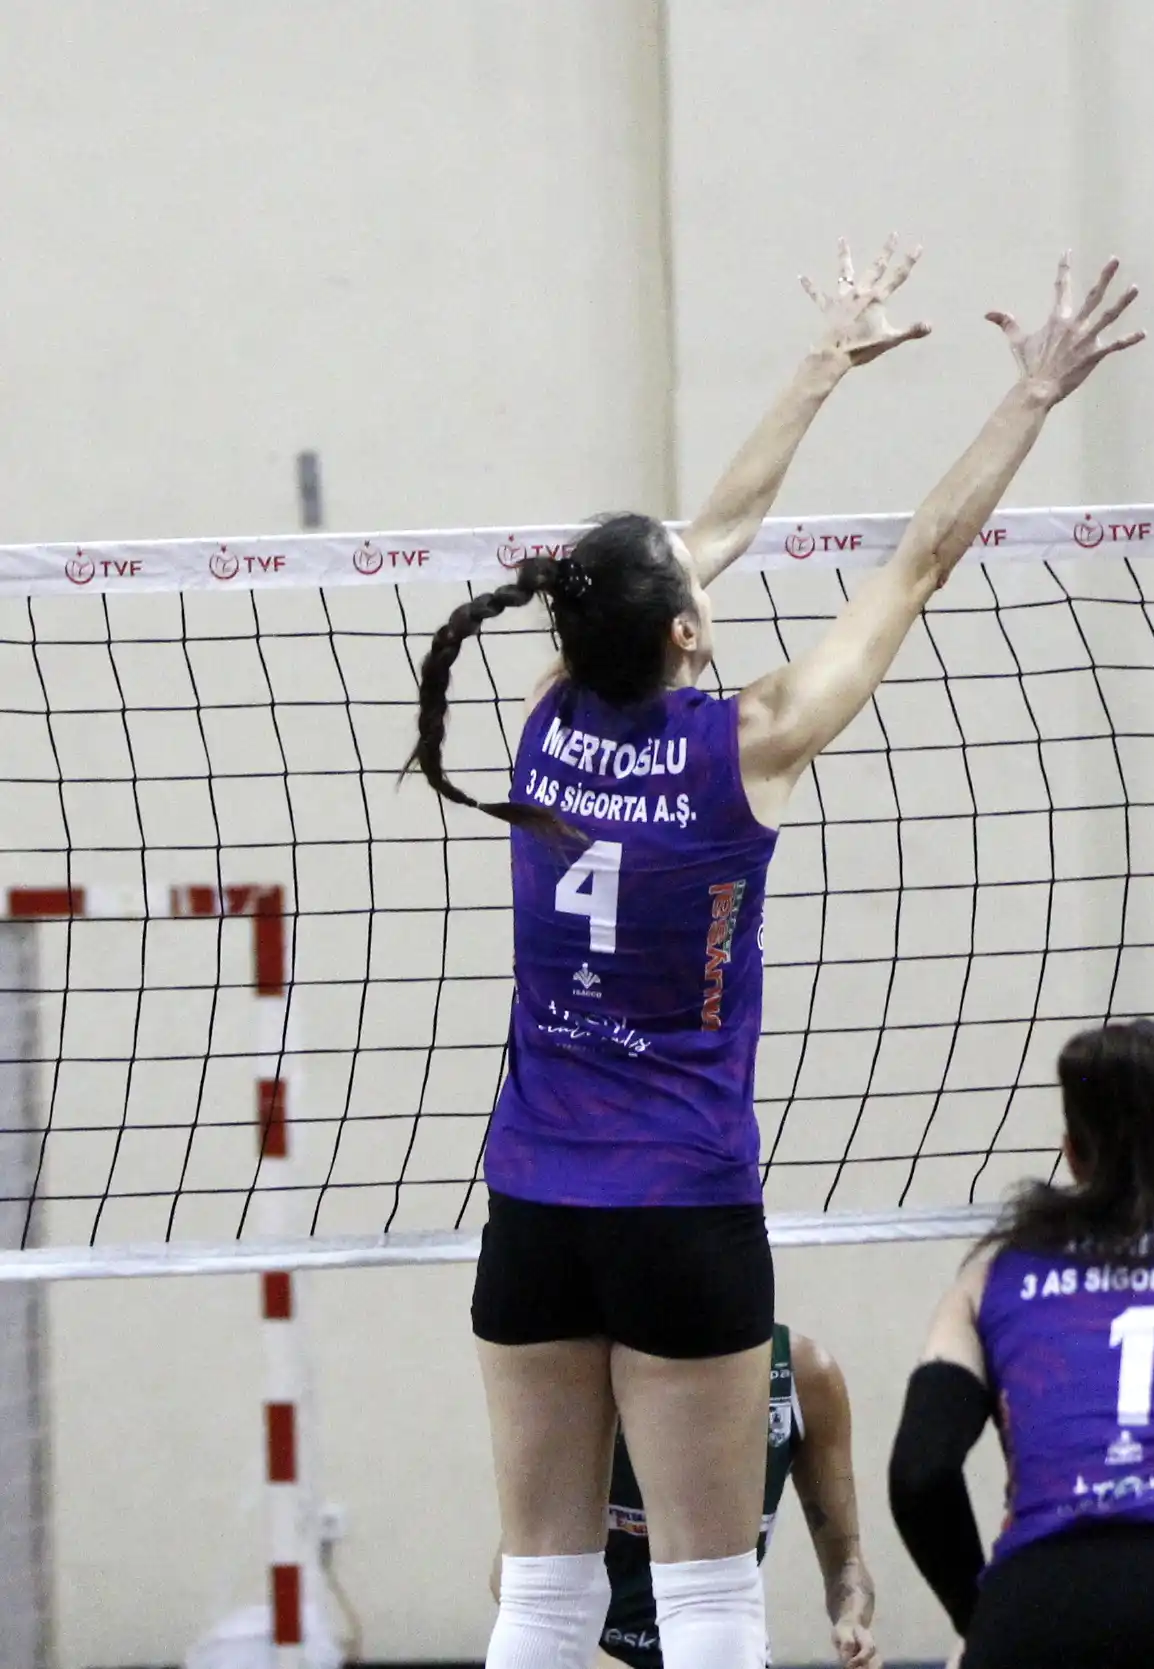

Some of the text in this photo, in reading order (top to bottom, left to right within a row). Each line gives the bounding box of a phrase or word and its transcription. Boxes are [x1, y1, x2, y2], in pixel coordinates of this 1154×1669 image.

[978, 528, 1007, 546] VF
[1109, 522, 1151, 541] TVF
[820, 533, 862, 551] TVF
[100, 559, 142, 577] TVF
[244, 555, 286, 573] TVF
[387, 549, 429, 568] TVF
[526, 769, 697, 828] 3 AS SİGORTA A.Ş.
[555, 840, 623, 954] 4
[1020, 1273, 1038, 1300] 3
[1041, 1268, 1078, 1297] AS
